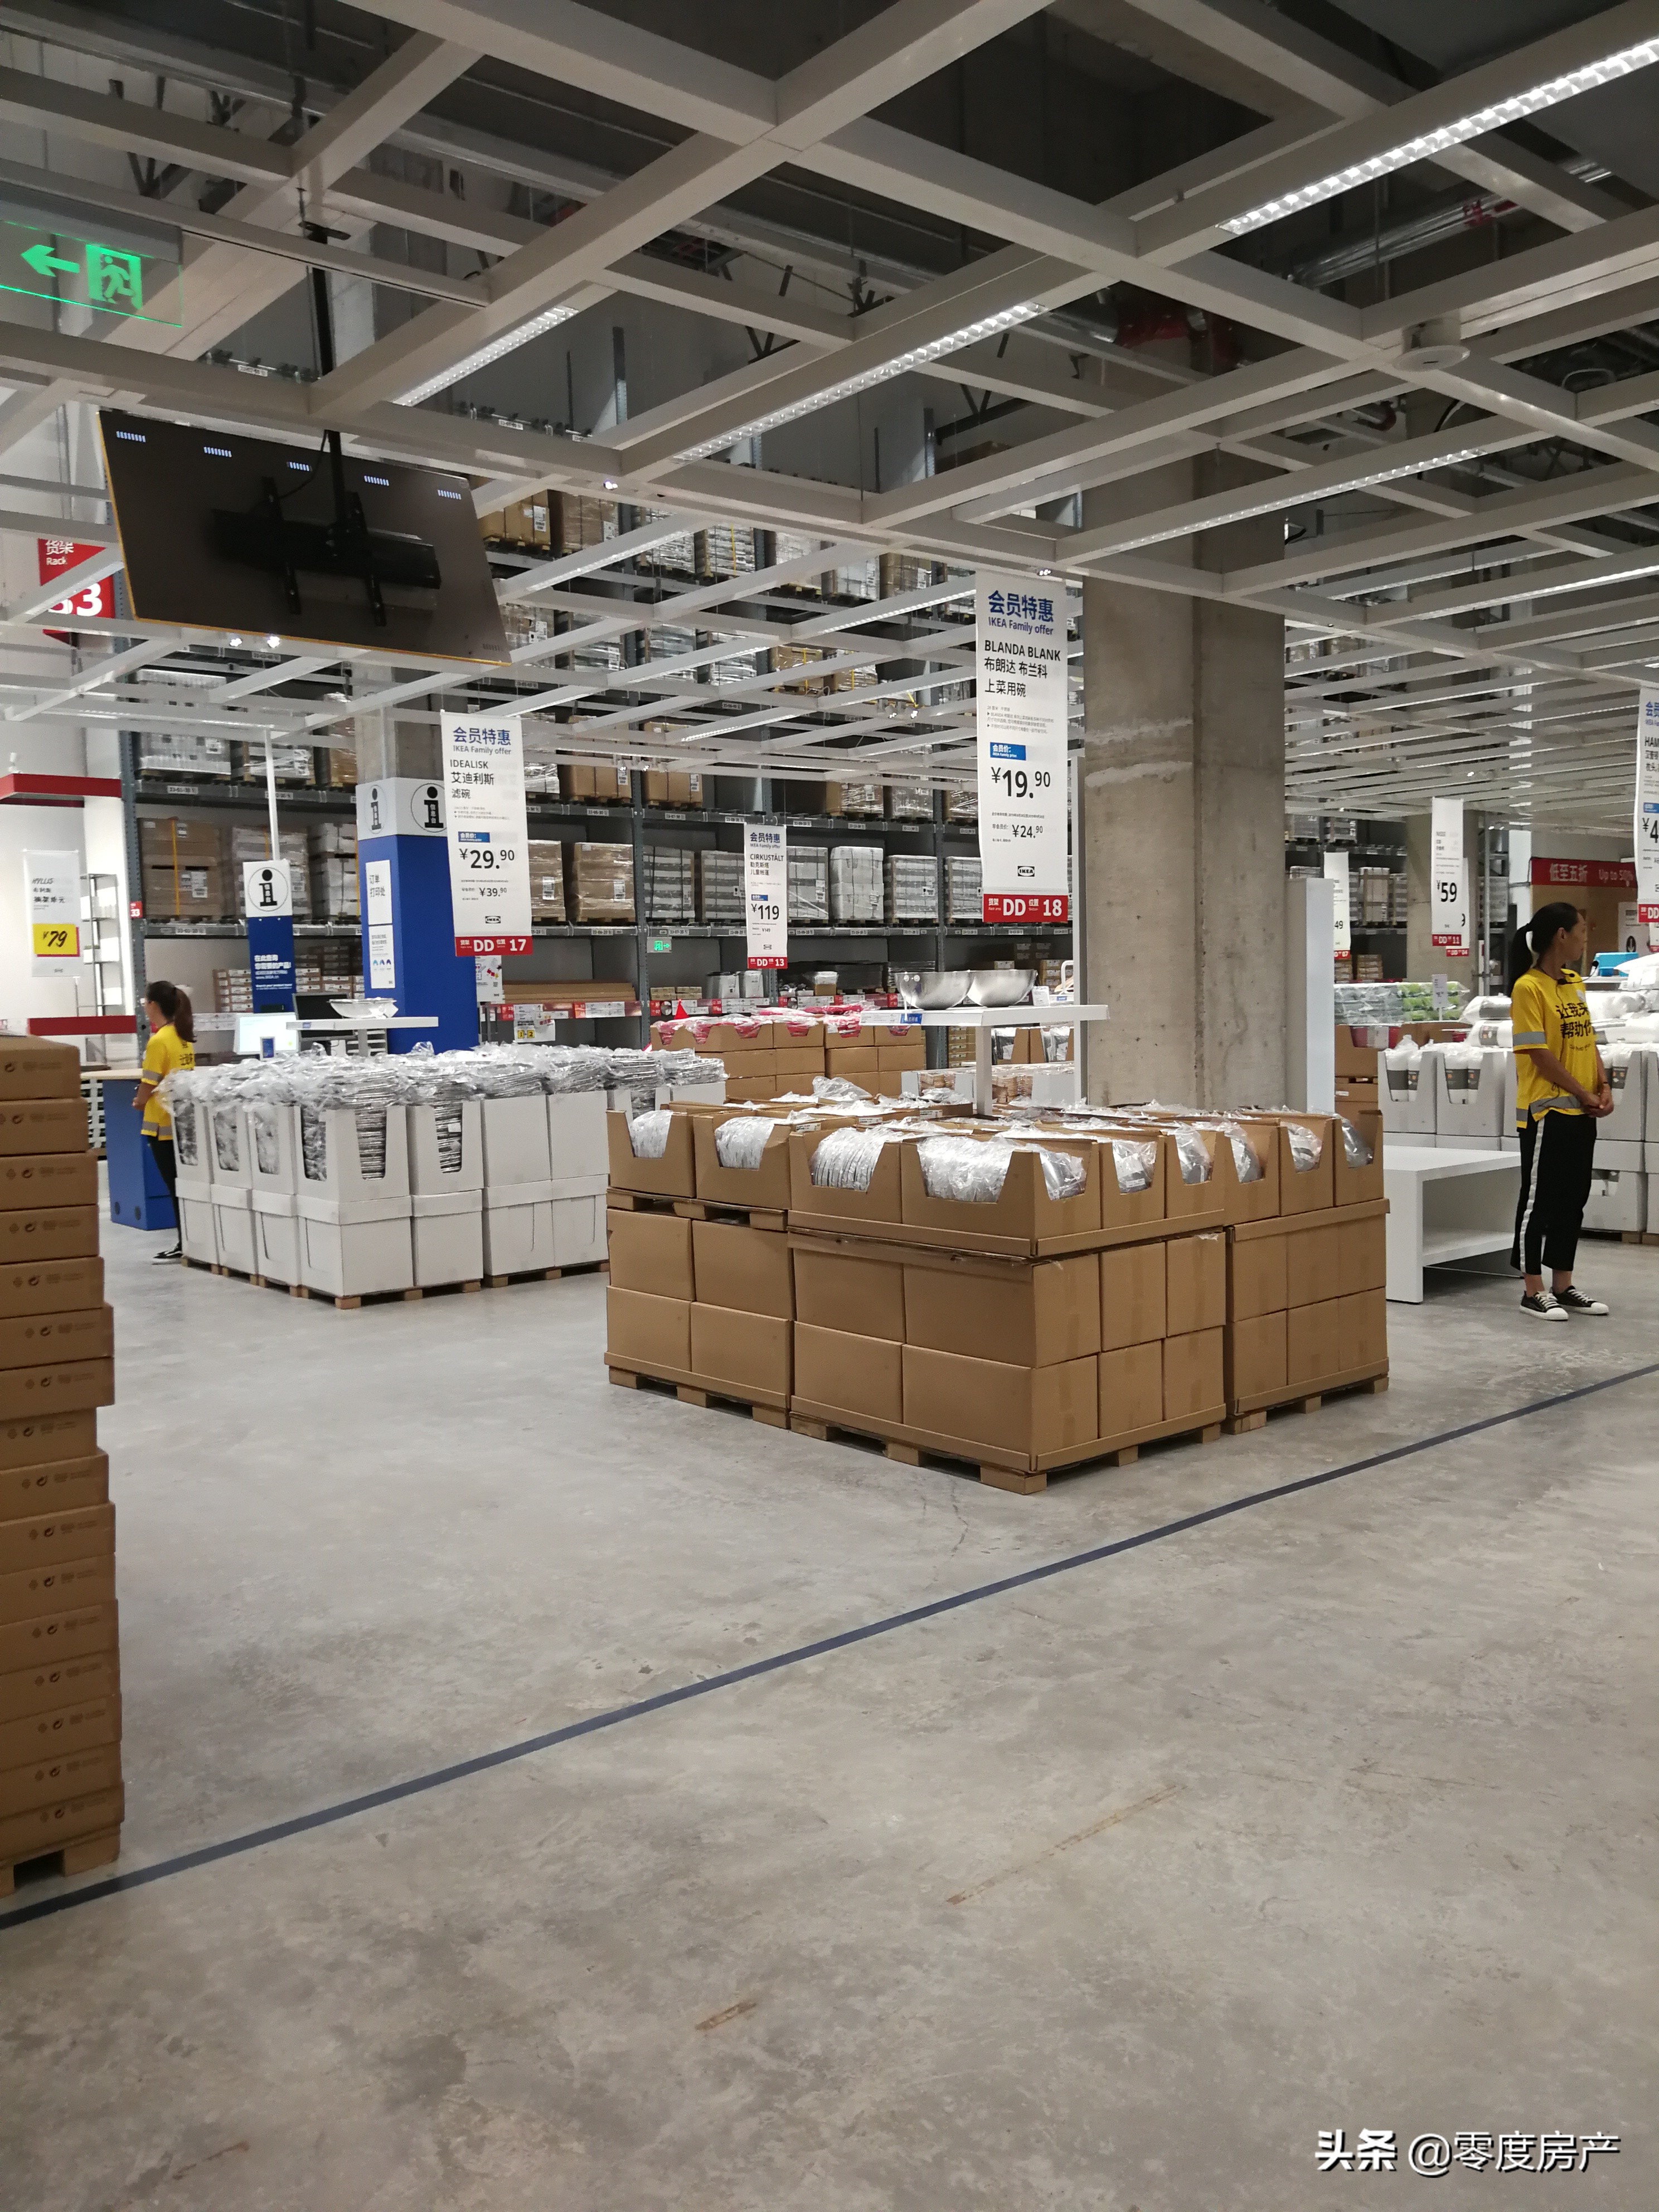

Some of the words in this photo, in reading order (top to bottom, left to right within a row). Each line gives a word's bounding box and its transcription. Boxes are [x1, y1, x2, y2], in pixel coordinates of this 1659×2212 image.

[988, 590, 1054, 622] 会员特惠
[988, 617, 1007, 628] IKEA
[1009, 619, 1033, 634] Family
[1035, 624, 1053, 635] offer
[984, 640, 1025, 656] BLANDA
[1028, 647, 1060, 661] BLANK
[984, 657, 1016, 673] 布朗达
[1018, 661, 1047, 678] 布兰科
[985, 678, 1026, 697] 上菜用碗
[453, 726, 511, 745] 会员特惠
[471, 746, 493, 755] Family
[450, 759, 488, 769] IDEALISK
[451, 772, 494, 785] 艾迪利斯
[991, 767, 1050, 798] ¥19.90
[452, 788, 470, 799] 滤碗
[750, 832, 780, 843] 会员特惠
[1012, 824, 1043, 838] ¥24.90
[459, 848, 515, 869] ¥29.90
[1550, 864, 1588, 882] 低至五折
[1599, 869, 1609, 883] Up
[1610, 871, 1617, 881] to
[479, 887, 507, 896] ¥39.90
[1437, 880, 1457, 902] ¥59
[130, 908, 140, 917] 33
[751, 904, 779, 920] ¥119
[1003, 899, 1026, 916] DD
[1044, 899, 1062, 916] 18
[474, 940, 494, 952] DD
[510, 939, 526, 951] 17
